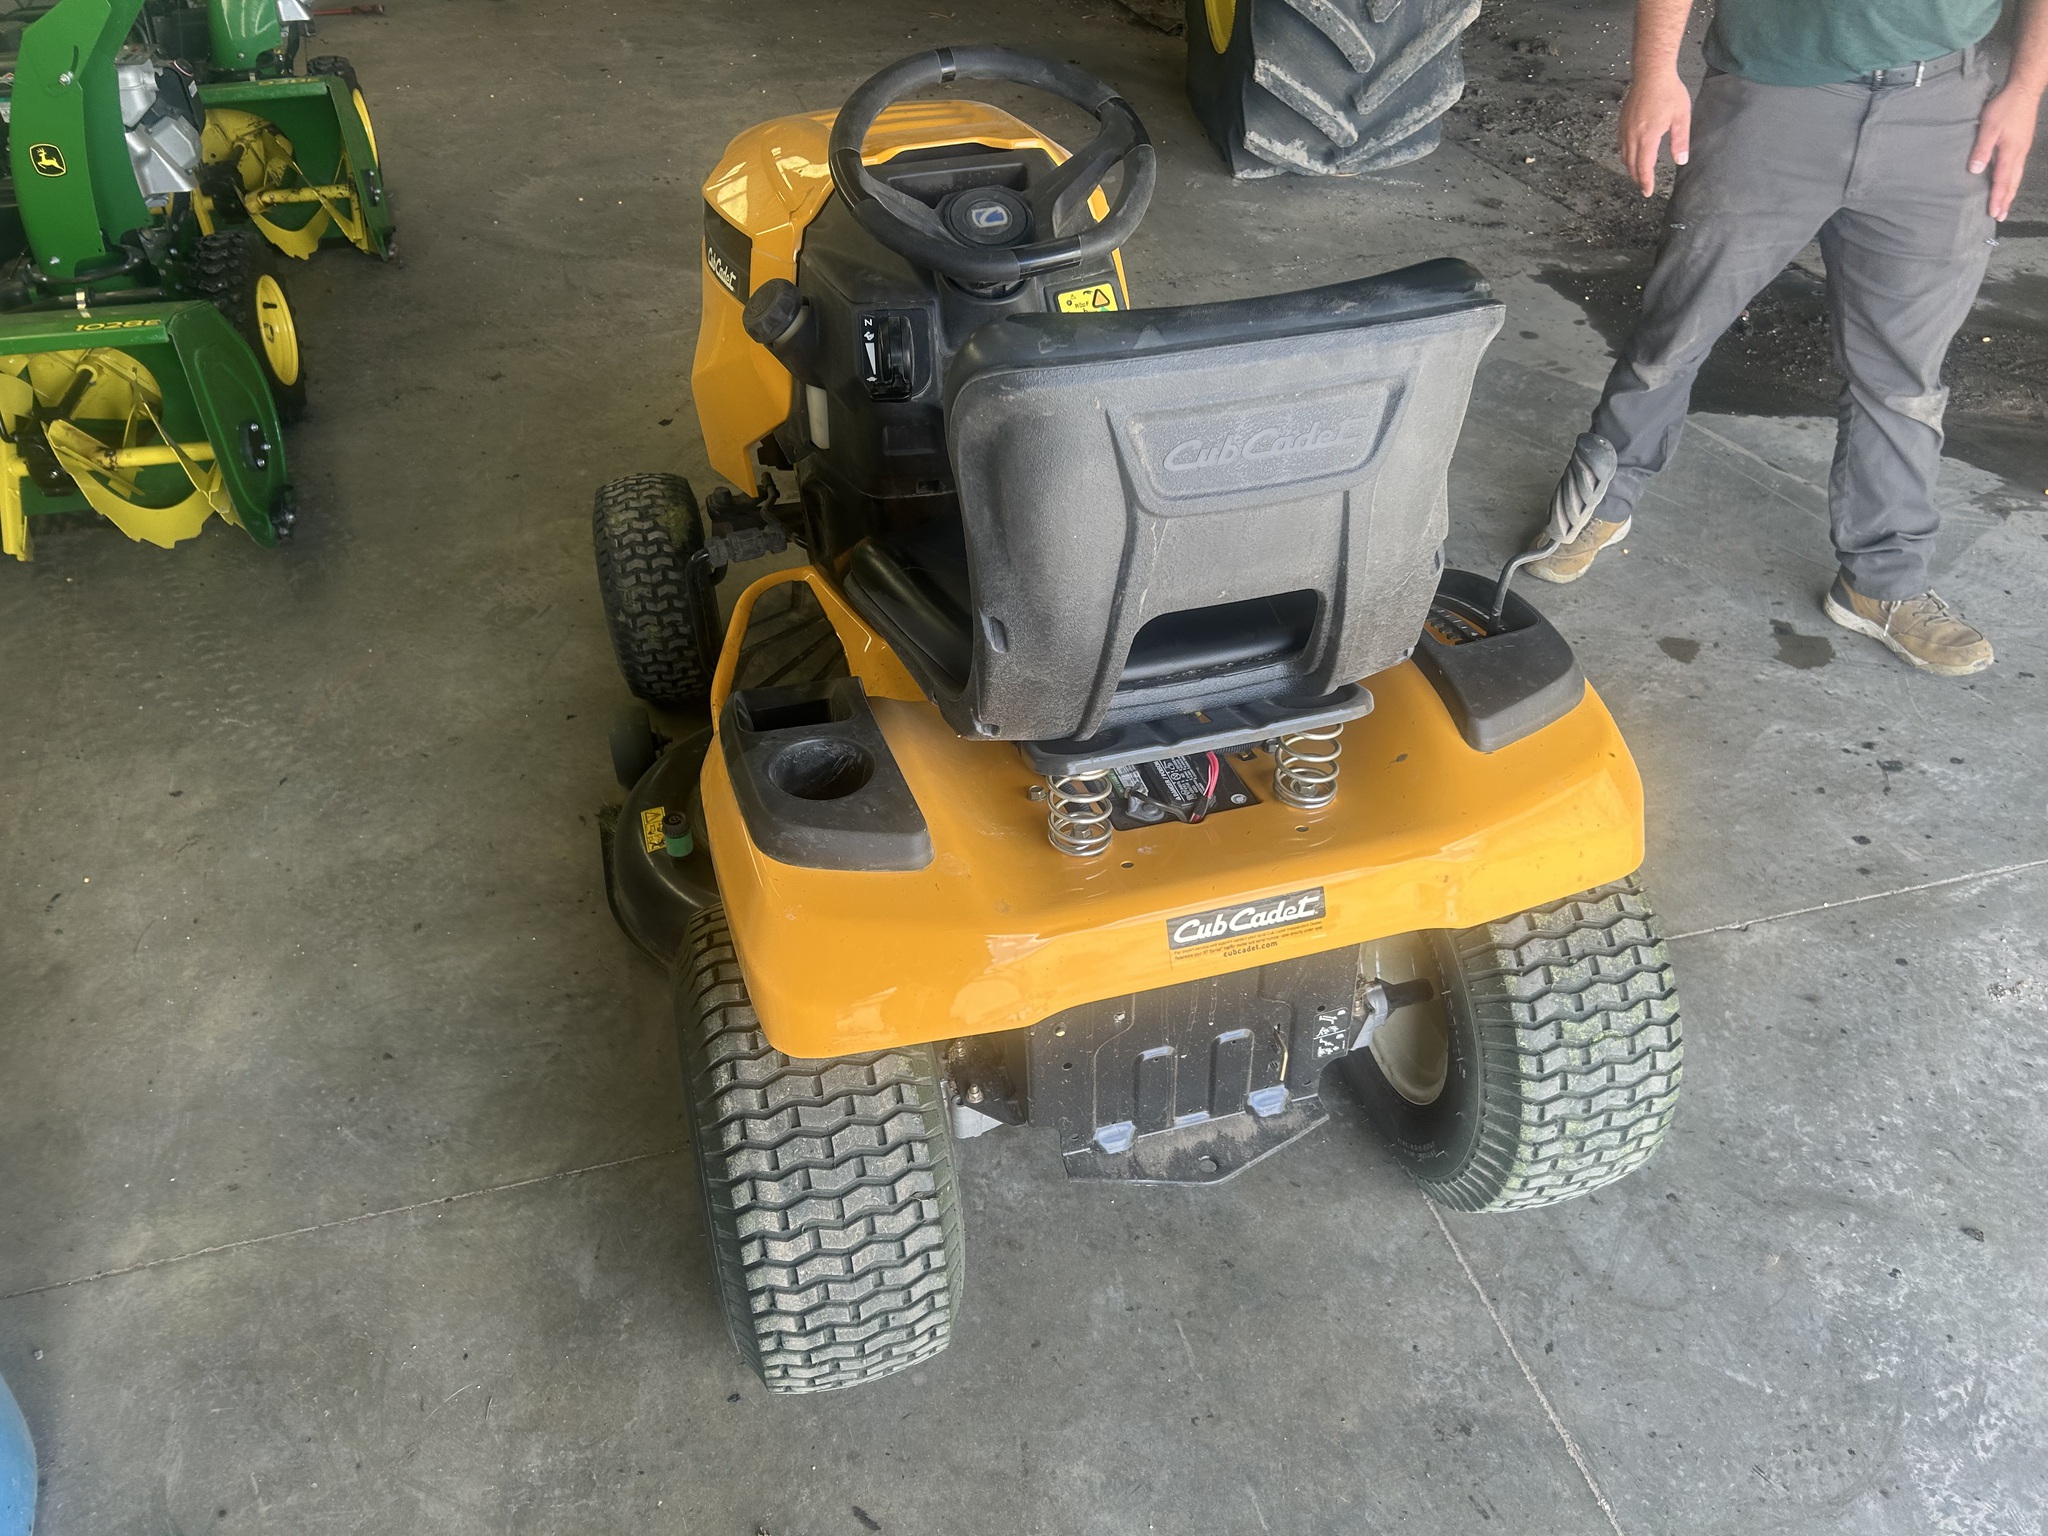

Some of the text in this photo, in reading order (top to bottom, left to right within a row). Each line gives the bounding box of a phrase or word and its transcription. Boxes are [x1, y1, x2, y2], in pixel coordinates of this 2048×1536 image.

[1162, 415, 1368, 472] Cub Cadet
[1173, 895, 1320, 943] Cub Cadet
[1223, 941, 1278, 957] cubcadet.com
